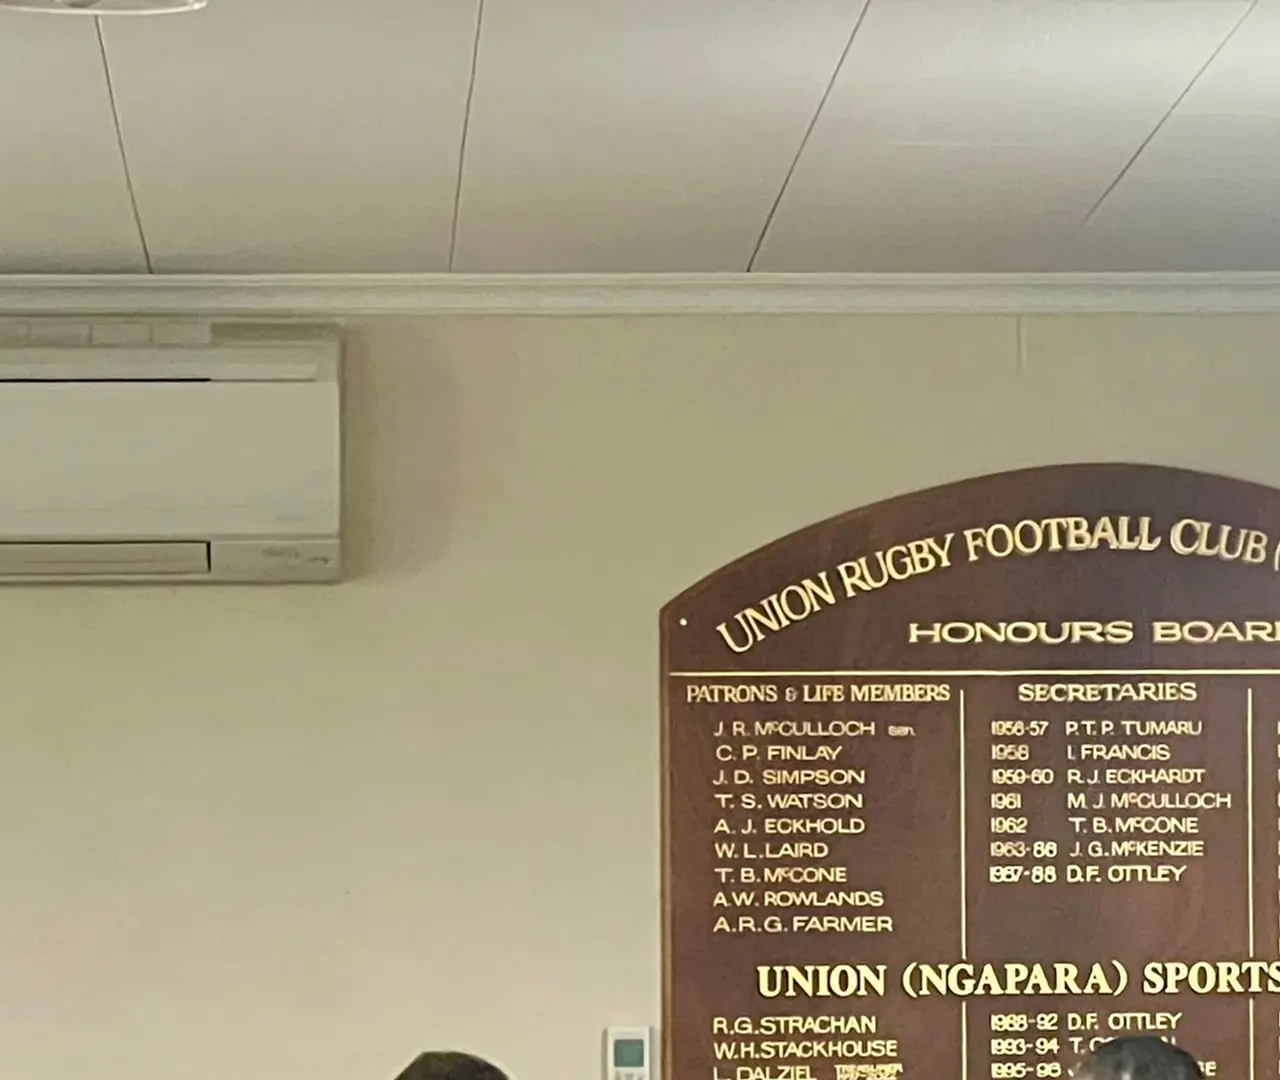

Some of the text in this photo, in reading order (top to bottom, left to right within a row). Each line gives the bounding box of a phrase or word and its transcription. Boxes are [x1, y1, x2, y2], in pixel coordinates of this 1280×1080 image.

[716, 571, 837, 654] UNION
[837, 533, 956, 599] RUGBY
[963, 515, 1162, 563] FOOTBALL
[1169, 518, 1269, 565] CLUB
[908, 621, 1135, 645] HONOURS
[685, 683, 951, 704] PATRONS & LIFE MEMBERS
[1018, 682, 1198, 703] SECRETARIES
[1120, 719, 1203, 737] TUMARU
[767, 744, 843, 762] FINLAY
[991, 743, 1030, 761] 1958
[1080, 743, 1172, 761] FRANCIS
[762, 768, 866, 786] SIMPSON
[1105, 767, 1207, 785] ECKHARDT
[766, 792, 863, 810] WATSON
[990, 791, 1022, 810] 1961
[764, 817, 866, 835] ECKHOLD
[990, 815, 1028, 834] 1962
[1107, 864, 1188, 884] OTTLEY
[763, 890, 885, 908] ROWLANDS
[792, 915, 894, 933] FARMER
[756, 964, 887, 998] UNION
[902, 959, 1129, 998] (NGAPARA)
[990, 1011, 1059, 1032] 1988-92
[1107, 1011, 1183, 1032] OTTLEY
[990, 1035, 1061, 1056] 1993-94
